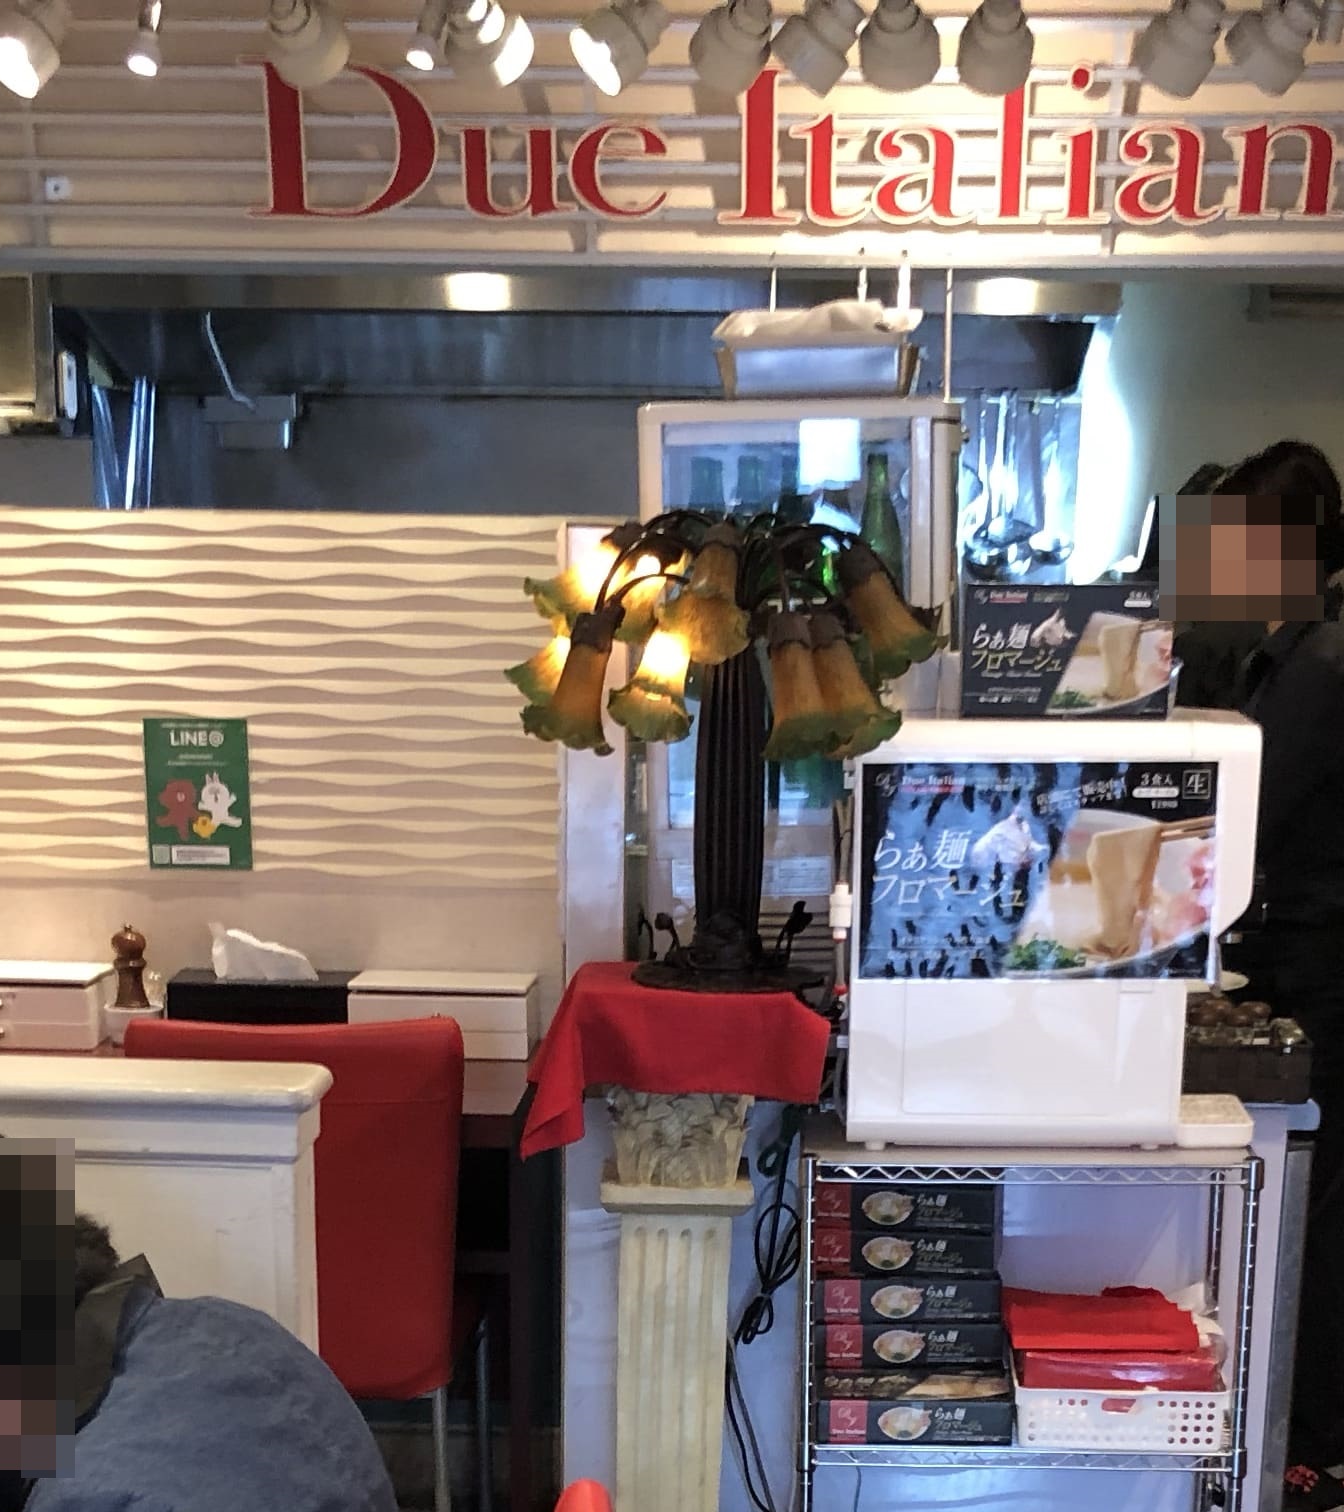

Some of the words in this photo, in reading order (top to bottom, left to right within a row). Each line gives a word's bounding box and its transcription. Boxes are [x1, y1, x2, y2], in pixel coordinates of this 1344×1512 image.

[244, 58, 668, 219] Due
[972, 623, 1032, 650] らぁ麺
[971, 649, 1063, 673] フロマージュ
[874, 829, 972, 872] らぁ麺
[871, 874, 1025, 908] フロマージュ
